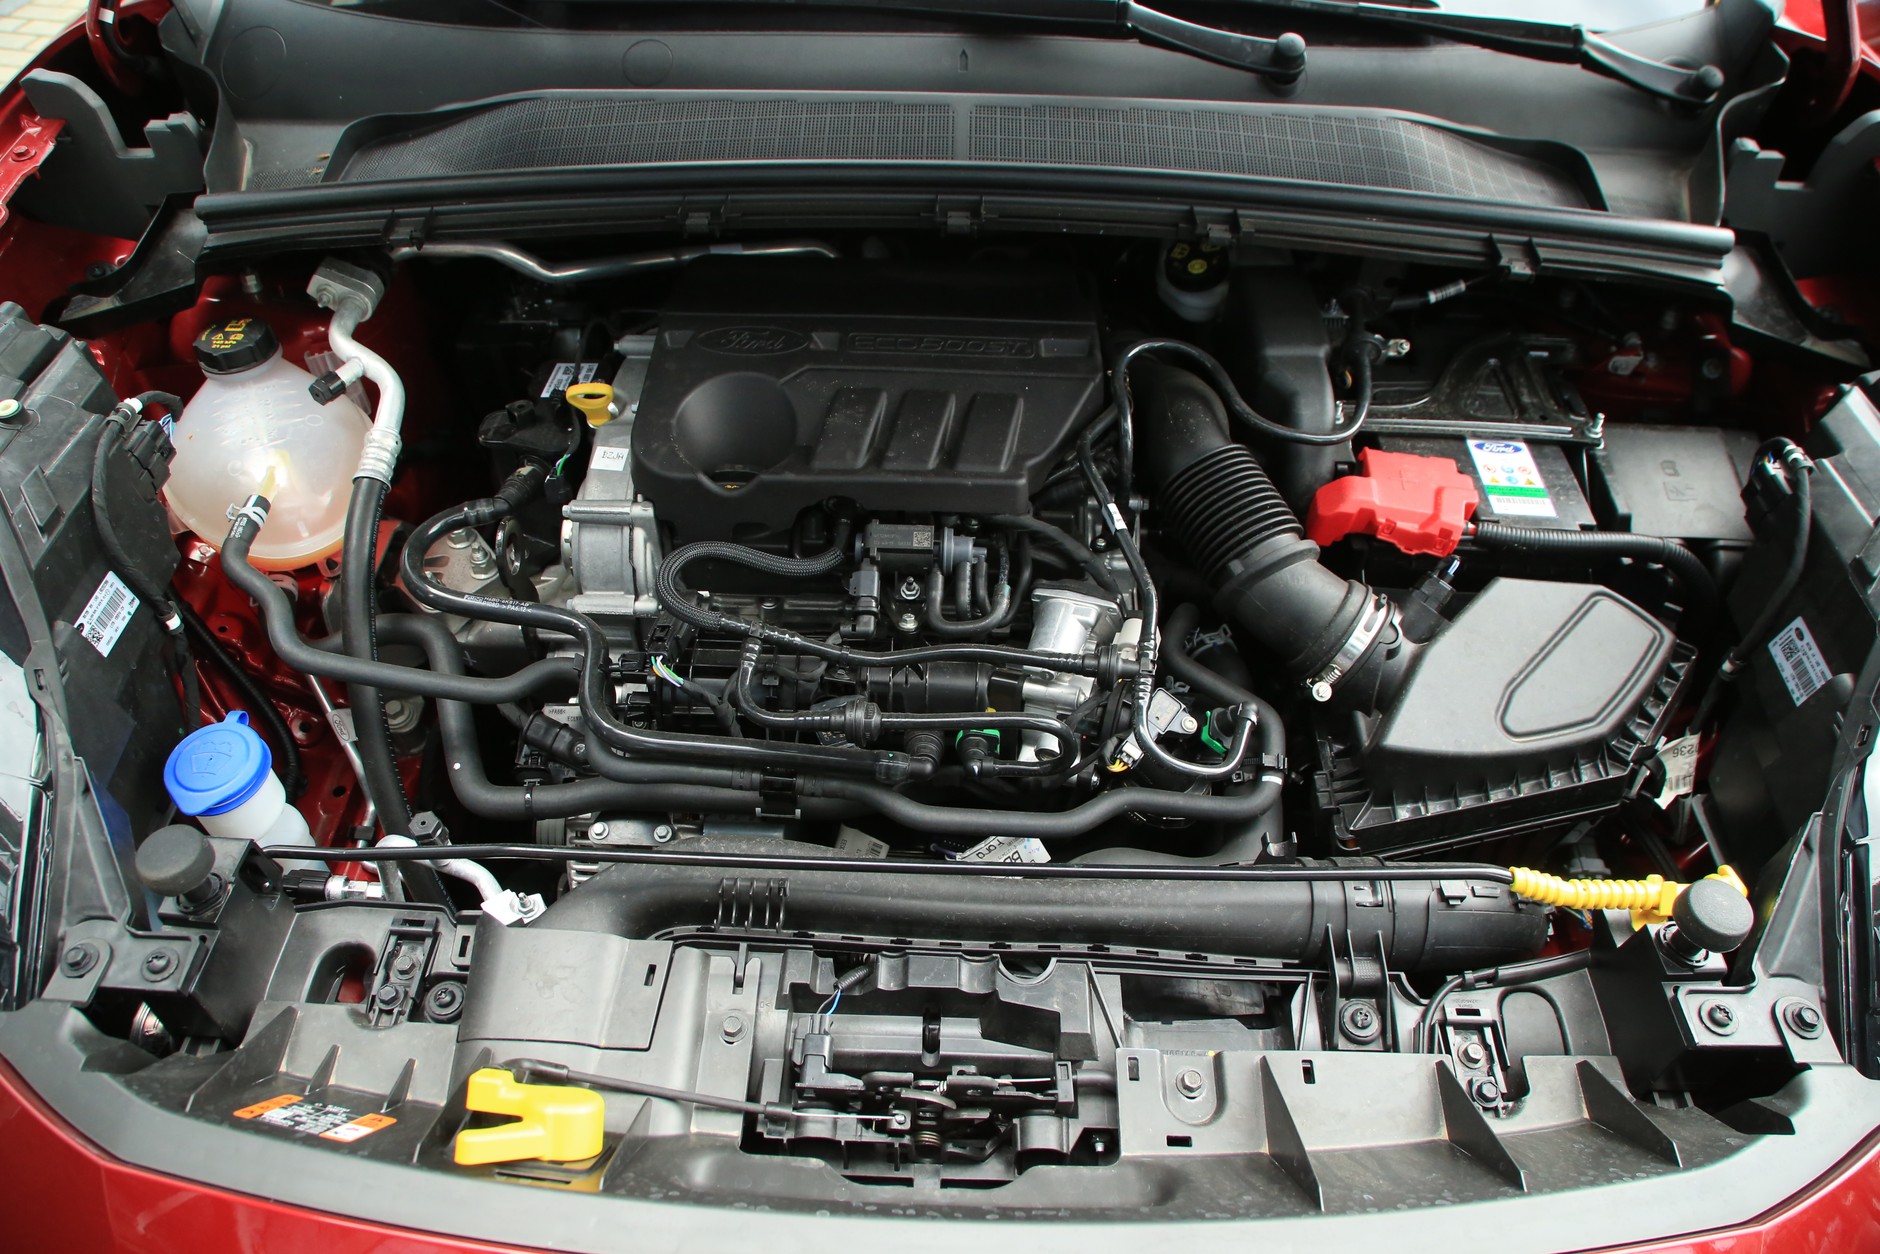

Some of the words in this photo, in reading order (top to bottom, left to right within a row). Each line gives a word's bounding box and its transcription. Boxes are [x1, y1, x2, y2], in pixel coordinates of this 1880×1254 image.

[720, 330, 784, 351] Ford
[854, 335, 1029, 355] ECOBOOST
[1482, 442, 1516, 453] Ford
